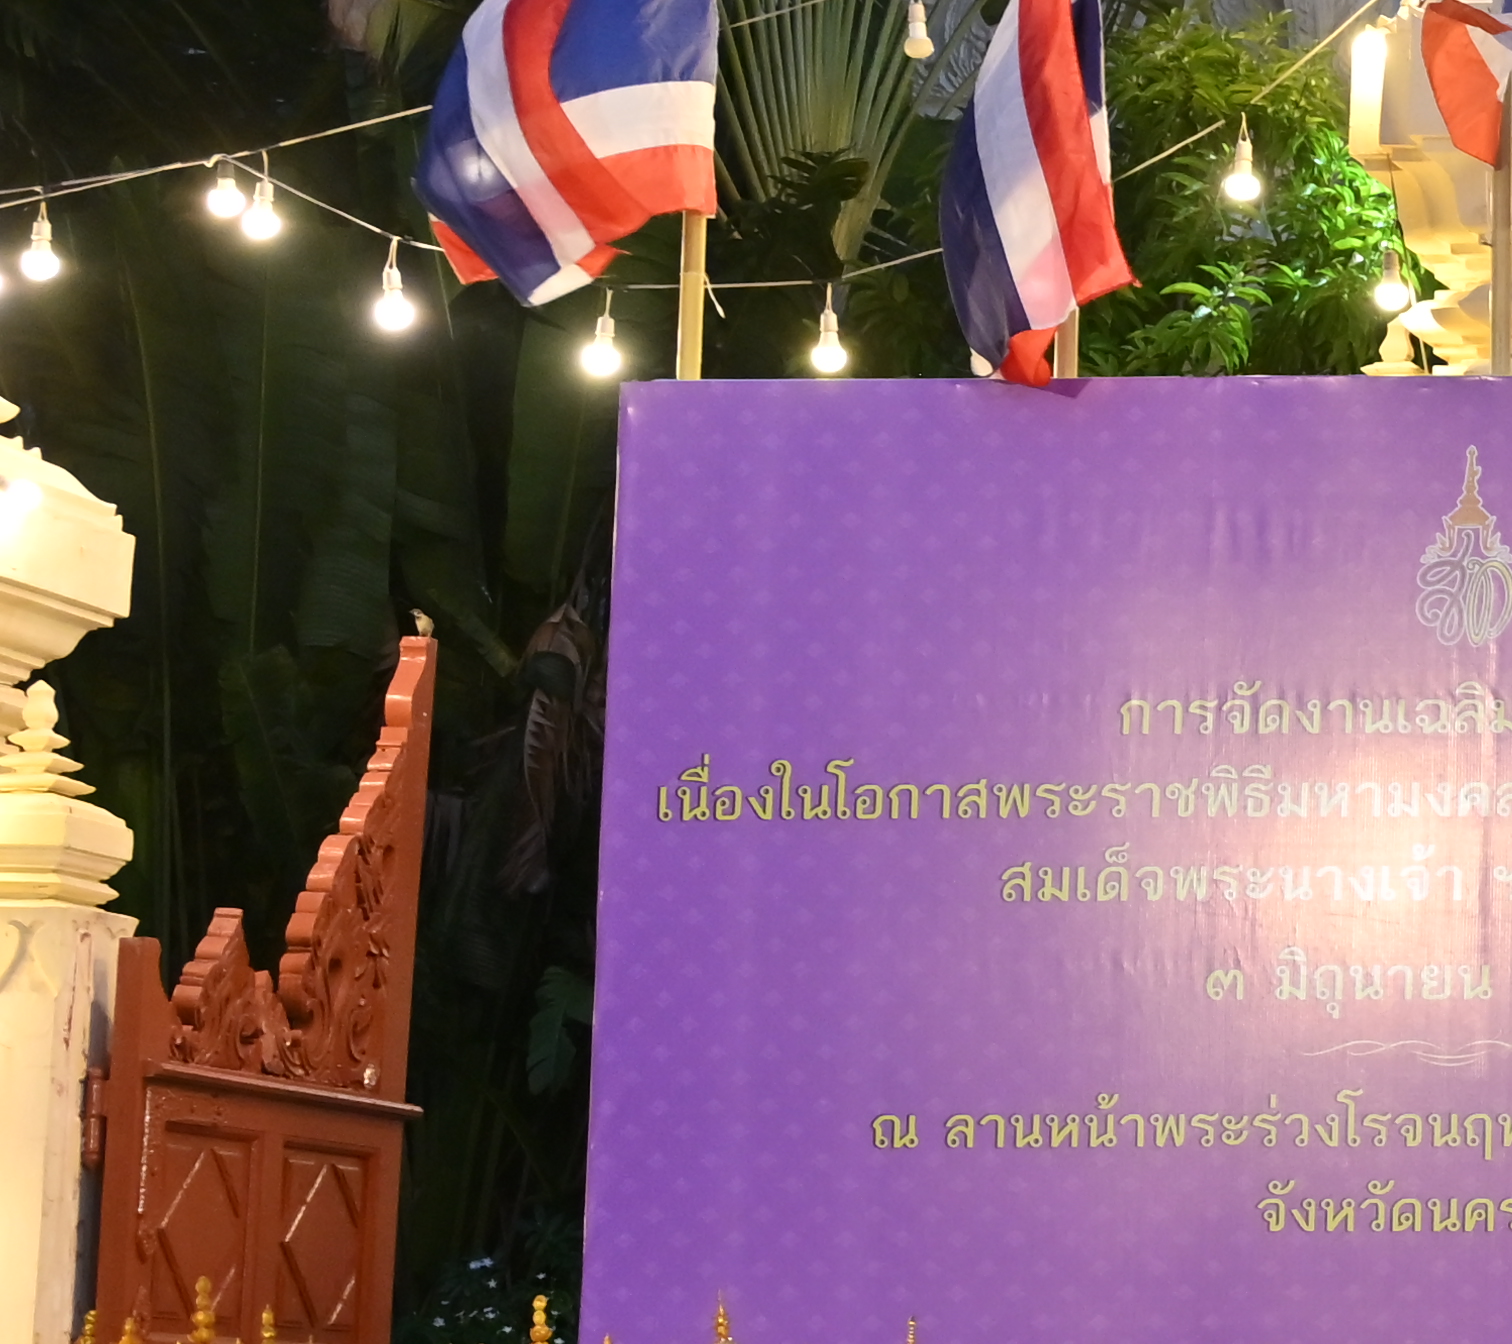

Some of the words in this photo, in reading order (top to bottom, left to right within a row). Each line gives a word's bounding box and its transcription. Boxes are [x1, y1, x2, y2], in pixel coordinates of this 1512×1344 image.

[1000, 843, 1464, 902] สมเด็จพระนางเจ้า
[1206, 968, 1244, 1001] ๓
[1276, 946, 1493, 1019] มิถุนายน
[871, 1112, 918, 1148] ณ
